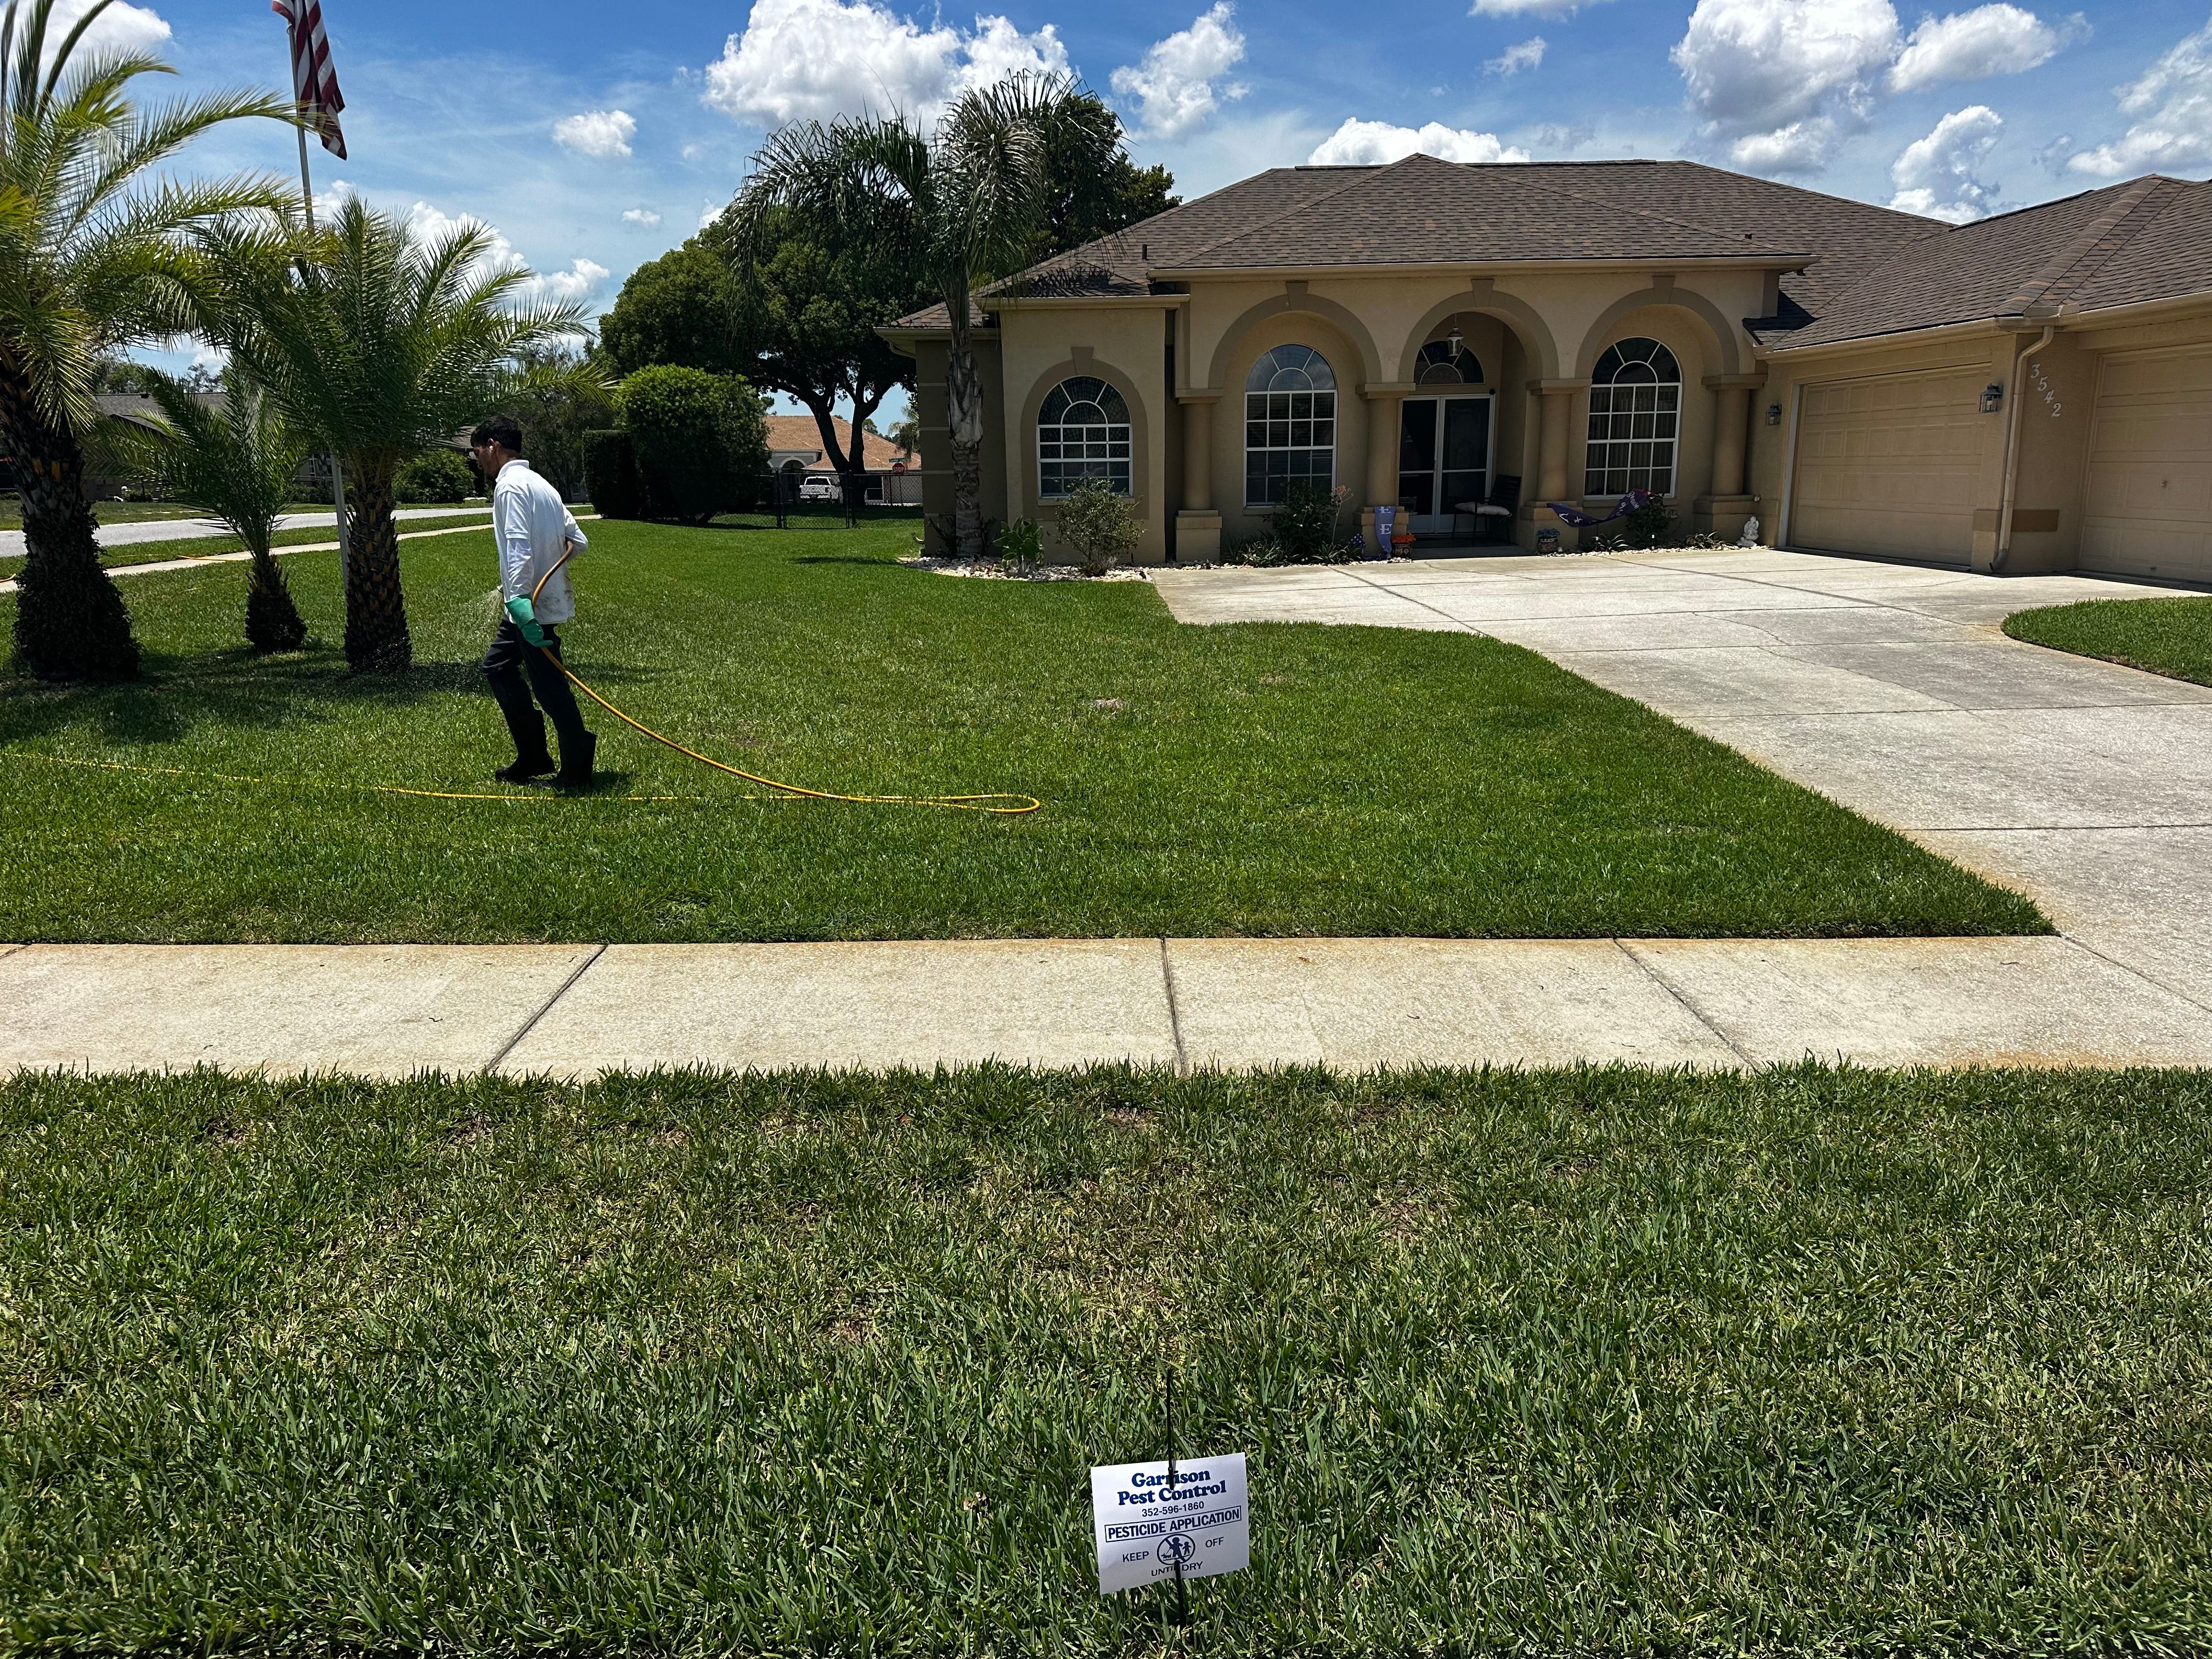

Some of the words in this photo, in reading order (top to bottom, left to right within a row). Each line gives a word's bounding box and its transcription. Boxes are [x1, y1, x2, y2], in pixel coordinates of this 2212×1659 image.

[2030, 363, 2062, 417] 3542
[1118, 1491, 1156, 1505] Pest
[1159, 1480, 1227, 1502] Control
[1142, 1501, 1204, 1517] 352-596-1860
[1108, 1522, 1166, 1539] PESTICIDE
[1170, 1509, 1240, 1532] APPLICATION
[1122, 1551, 1149, 1562] KEEP
[1205, 1537, 1224, 1548] OFF
[1182, 1561, 1203, 1571] DRY
